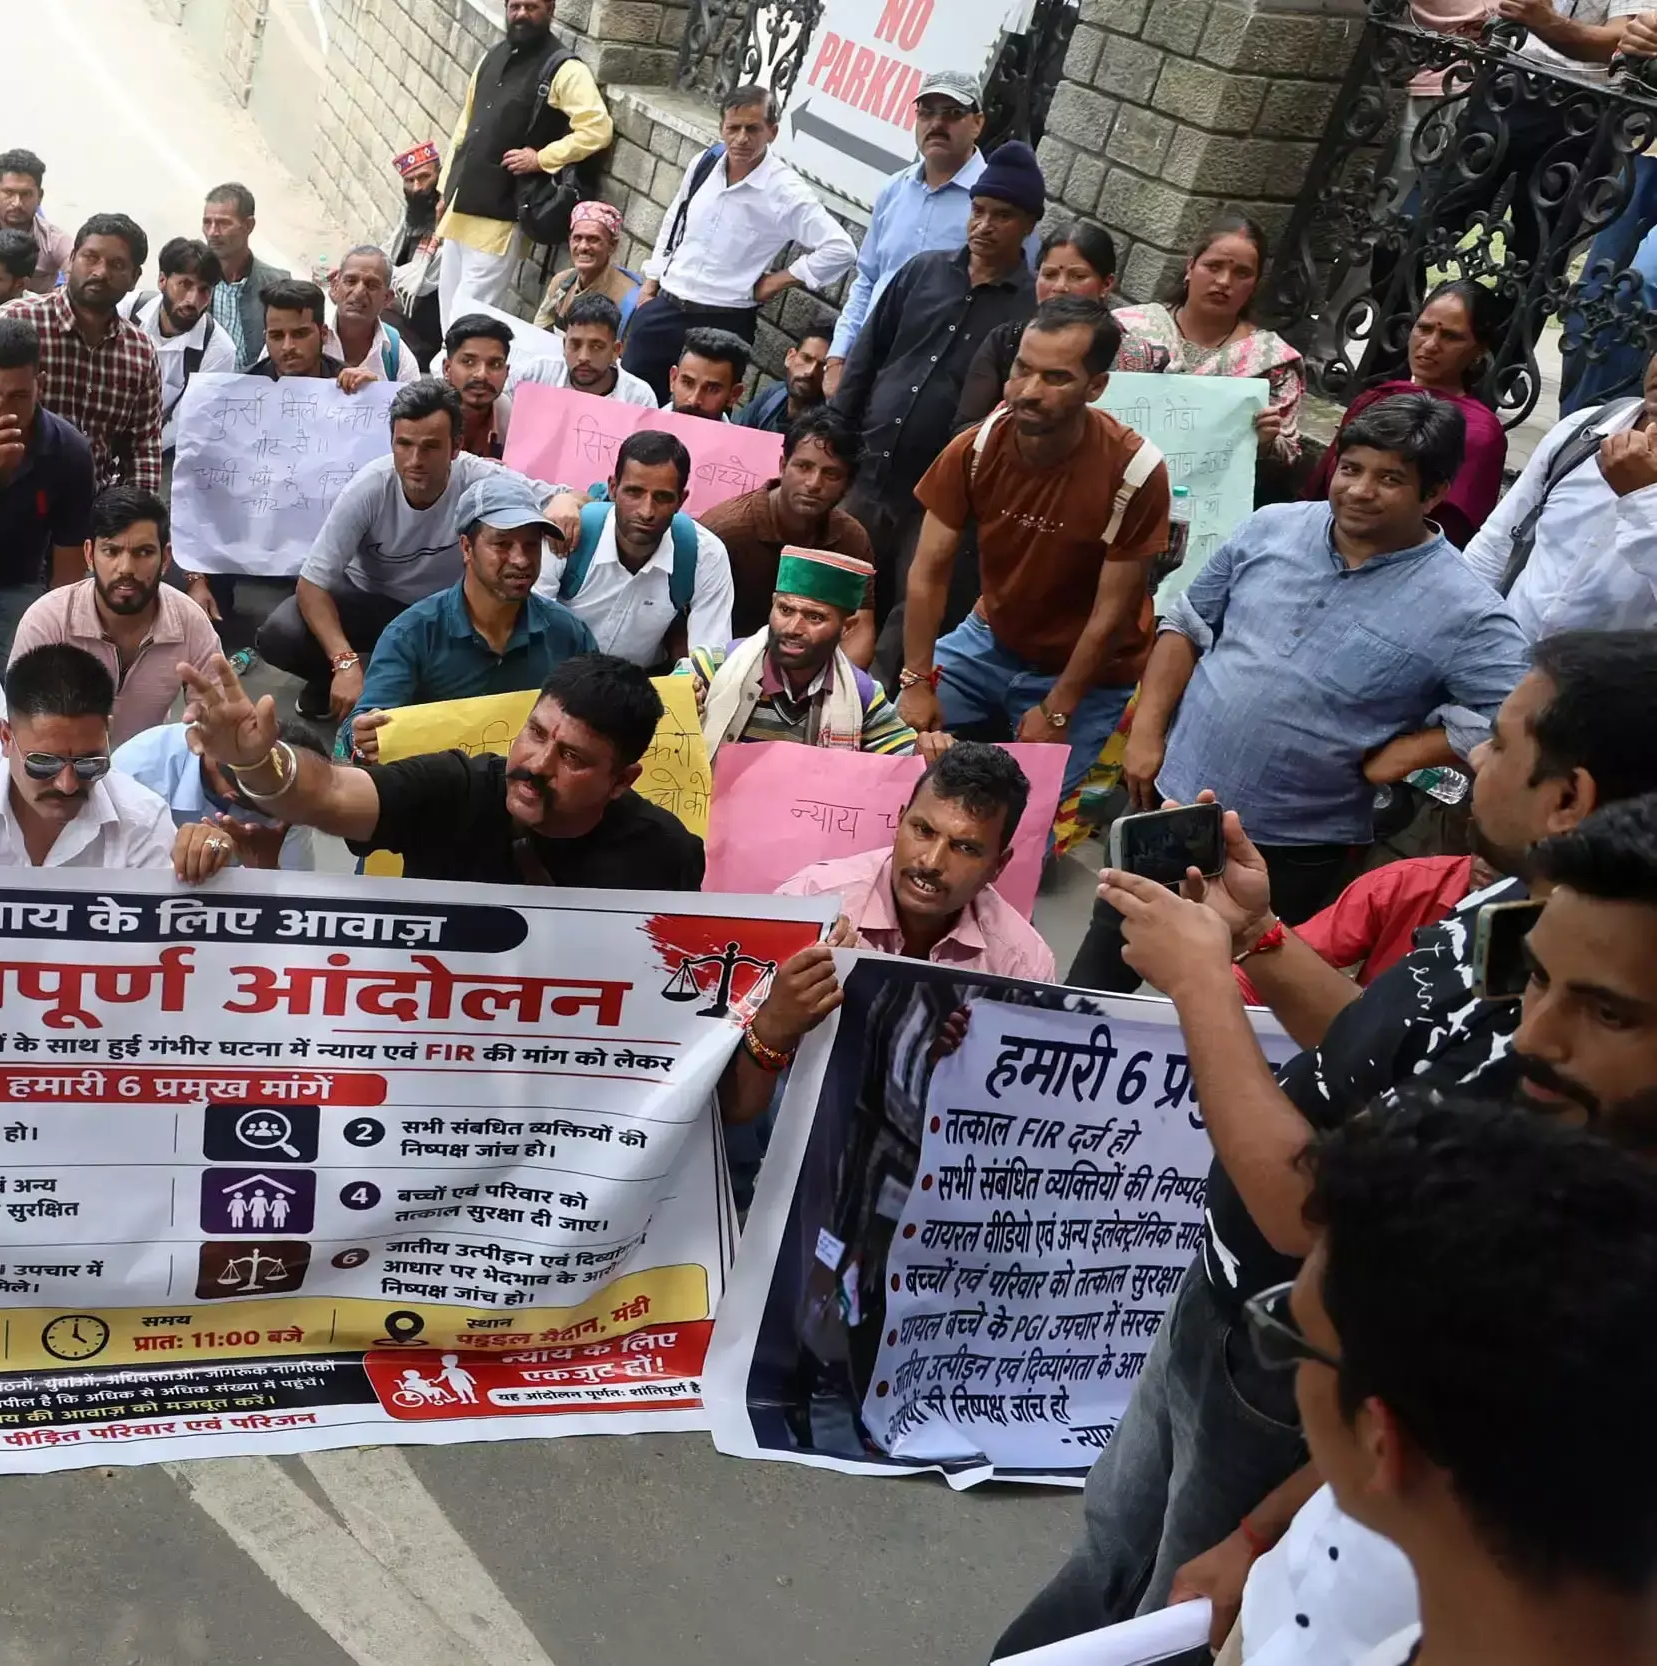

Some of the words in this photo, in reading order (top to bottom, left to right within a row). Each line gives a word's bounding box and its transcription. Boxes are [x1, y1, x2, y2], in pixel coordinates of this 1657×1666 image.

[874, 0, 935, 51] NO
[808, 31, 922, 131] PARKIN
[87, 897, 142, 933] के
[156, 899, 262, 934] लिए
[276, 910, 447, 946] आवाज़
[223, 954, 633, 1026] आंदोलन
[13, 1032, 40, 1052] के
[46, 1039, 100, 1053] साथ
[107, 1034, 142, 1059] हुई
[148, 1035, 212, 1056] गंभीर
[219, 1042, 283, 1056] घटना
[289, 1038, 311, 1057] में
[317, 1044, 377, 1059] न्याय
[383, 1042, 418, 1060] एवं
[426, 1044, 474, 1061] FIR
[483, 1043, 516, 1062] की
[522, 1046, 569, 1064] मांग
[575, 1048, 608, 1066] को
[614, 1049, 675, 1071] लेकर
[986, 1024, 1118, 1102] हमारी
[1117, 1051, 1153, 1105] 6
[7, 1070, 107, 1097] हमारी
[118, 1076, 140, 1096] 6
[153, 1077, 250, 1104] प्रमुख
[260, 1075, 333, 1099] मांगें
[356, 1124, 372, 1140] 2
[402, 1118, 445, 1134] सभी
[529, 1120, 613, 1142] व्यक्तियों
[619, 1130, 647, 1148] की
[946, 1109, 1017, 1146] तत्काल
[1017, 1118, 1065, 1148] FIR
[1068, 1118, 1114, 1154] दर्ज
[1109, 1118, 1142, 1157] हो
[400, 1139, 470, 1158] निष्पक्ष
[475, 1141, 519, 1157] जांच
[14, 1179, 57, 1192] अन्य
[939, 1154, 976, 1201] सभी
[980, 1157, 1044, 1200] संबंधित
[1045, 1160, 1126, 1201] व्यक्तियों
[1123, 1164, 1155, 1205] की
[7, 1198, 79, 1222] सुरक्षित
[351, 1188, 368, 1203] 4
[398, 1186, 447, 1202] बच्चों
[452, 1184, 479, 1199] एवं
[485, 1182, 554, 1203] परिवार
[559, 1192, 588, 1210] को
[395, 1206, 462, 1222] तत्काल
[467, 1206, 524, 1223] सुरक्षा
[531, 1209, 552, 1227] दी
[906, 1257, 959, 1298] बच्चों
[954, 1263, 990, 1298] एवं
[989, 1262, 1049, 1299] परिवार
[1049, 1259, 1076, 1298] को
[1075, 1265, 1131, 1296] तत्काल
[142, 1316, 192, 1326] समय
[467, 1318, 514, 1328] स्थान
[611, 1296, 651, 1323] मंडी
[191, 1331, 260, 1348] 11:00
[267, 1326, 304, 1343] बजे
[621, 1332, 677, 1352] लिए
[519, 1361, 615, 1385] एकजुट
[524, 1390, 581, 1399] आंदोलन
[629, 1382, 687, 1396] शांतिपूर्ण
[4, 1428, 80, 1448] पीड़ित
[88, 1423, 175, 1438] परिवार
[183, 1417, 222, 1431] एवं
[229, 1413, 316, 1428] परिजन
